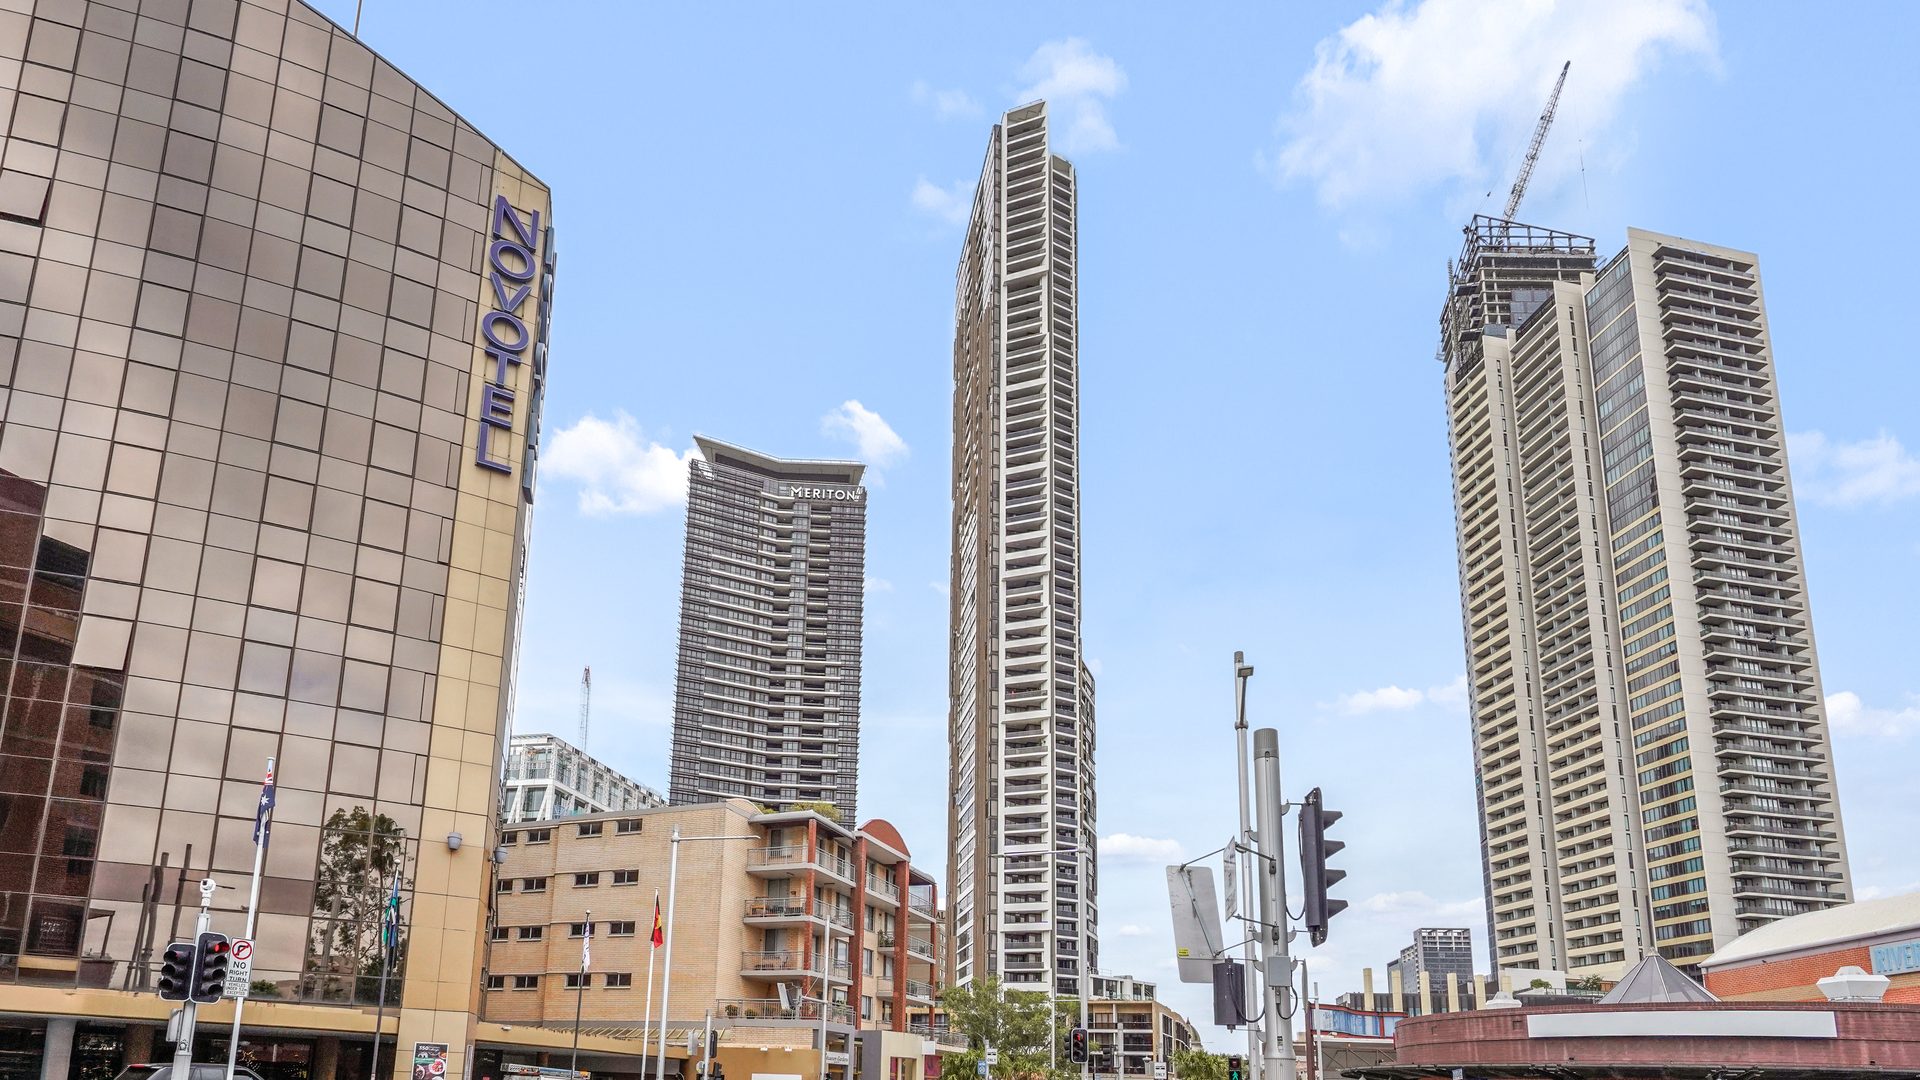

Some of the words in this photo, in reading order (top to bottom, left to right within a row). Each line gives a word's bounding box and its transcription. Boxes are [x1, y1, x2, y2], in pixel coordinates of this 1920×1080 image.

[475, 194, 540, 475] NOVOTEL
[790, 486, 855, 500] MERITON
[233, 961, 246, 969] NO
